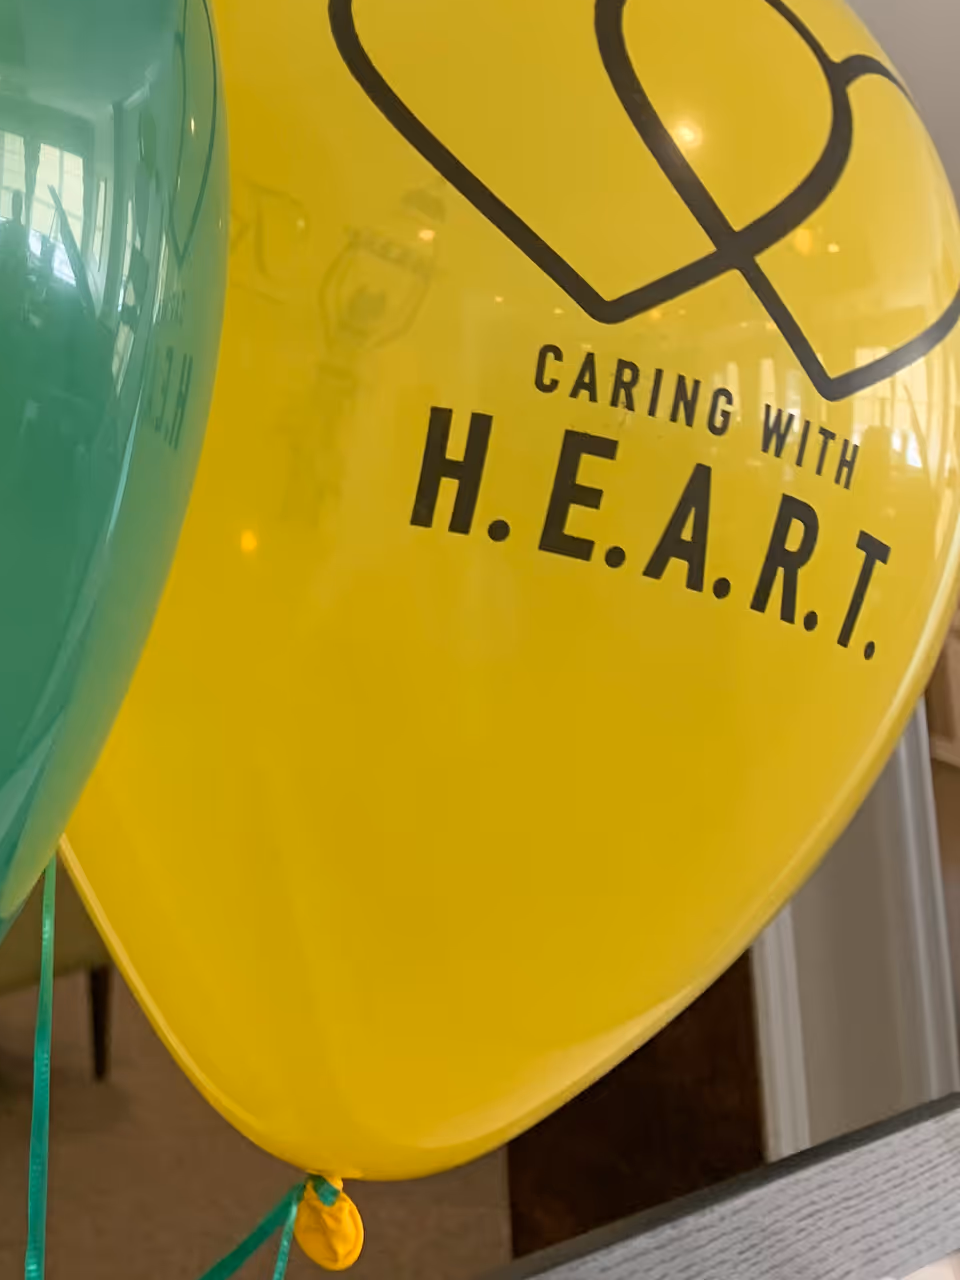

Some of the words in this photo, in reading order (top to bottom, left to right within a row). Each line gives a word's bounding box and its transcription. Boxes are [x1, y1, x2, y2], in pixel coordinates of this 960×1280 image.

[533, 343, 735, 437] CARING
[761, 403, 860, 491] WITH
[409, 405, 892, 661] H.E.A.R.T.
